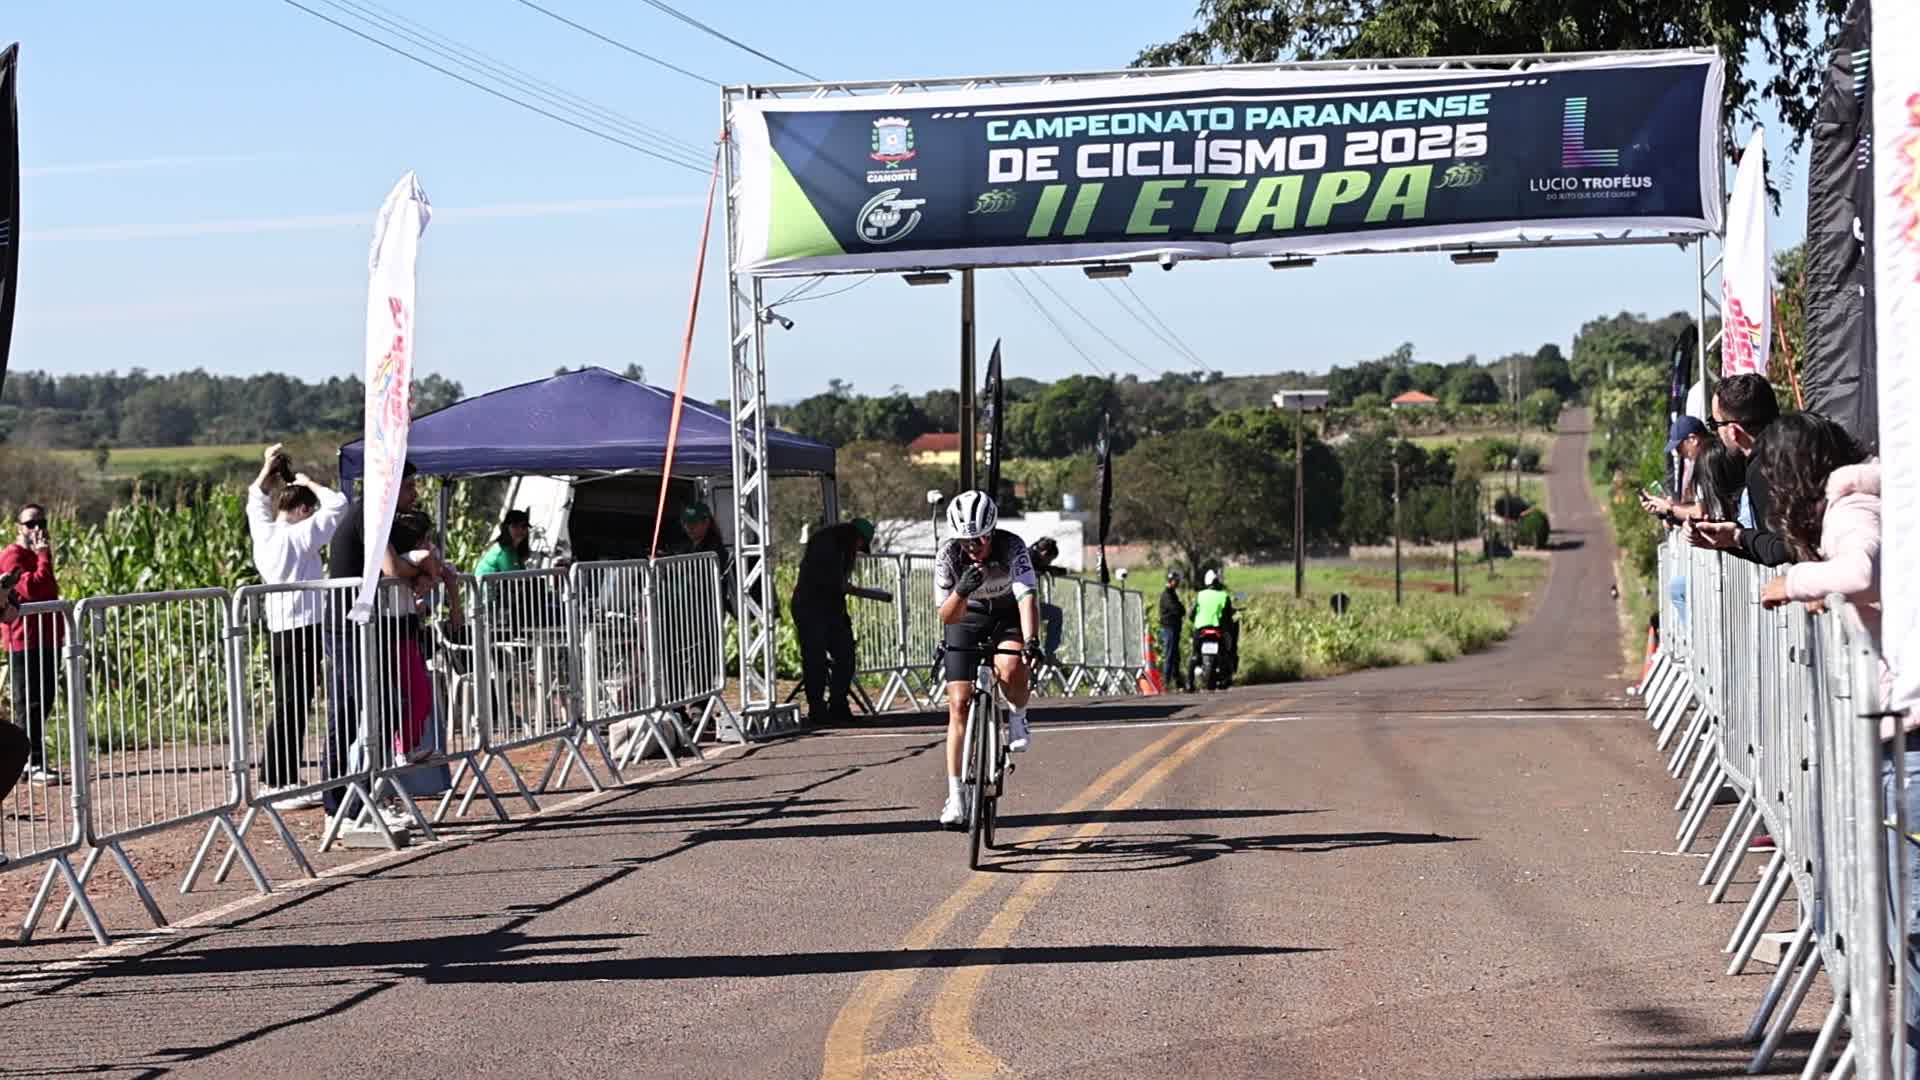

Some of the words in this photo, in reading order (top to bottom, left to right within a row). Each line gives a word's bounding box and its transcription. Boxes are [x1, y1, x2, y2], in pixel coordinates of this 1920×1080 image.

[986, 107, 1235, 142] CAMPEONATO
[1245, 93, 1491, 131] PARANAENSE
[866, 172, 918, 183] CIANORTE
[988, 146, 1060, 184] DE
[1076, 130, 1328, 179] CICLÍSMO
[1343, 122, 1488, 167] 2025
[1026, 184, 1104, 238] II
[1125, 164, 1434, 235] ETAPA
[1530, 177, 1578, 192] LUCIO
[1582, 174, 1653, 189] TROFÉUS
